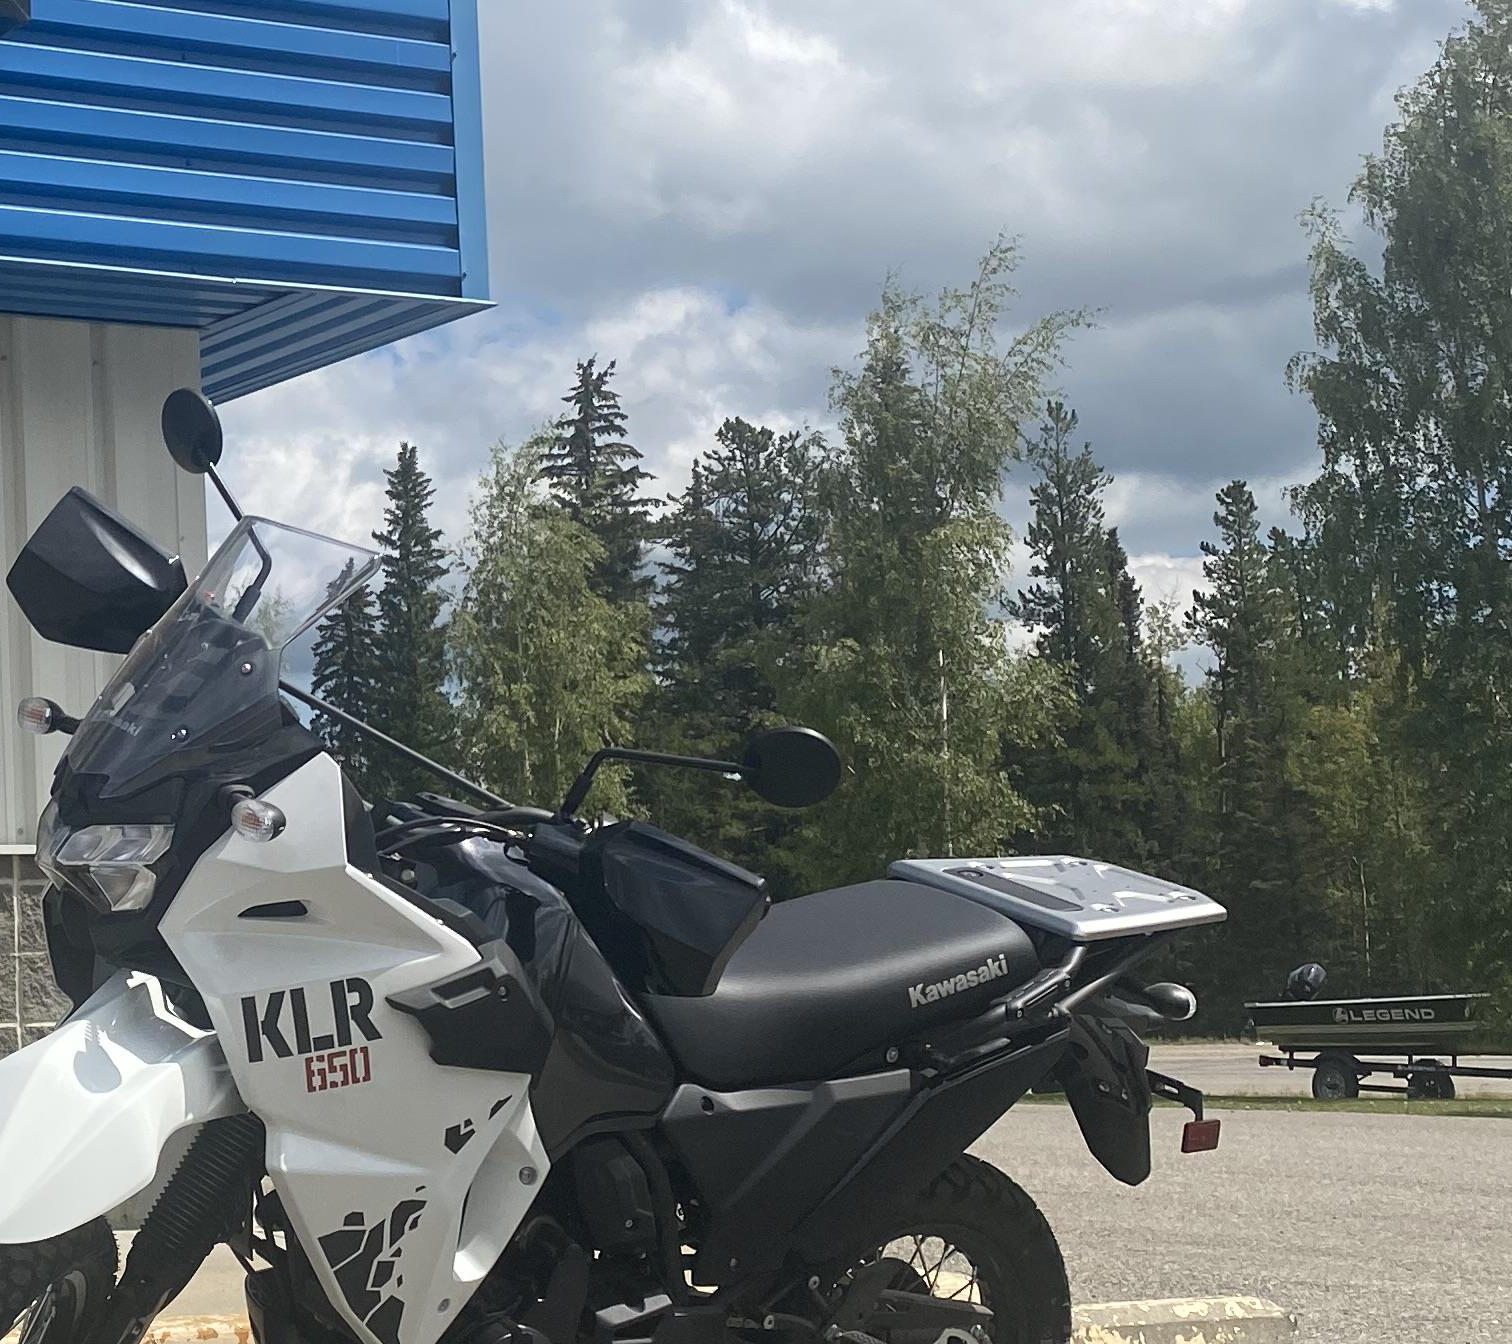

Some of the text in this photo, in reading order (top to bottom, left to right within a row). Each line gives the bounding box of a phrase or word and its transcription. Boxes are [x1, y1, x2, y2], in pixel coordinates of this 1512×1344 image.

[908, 953, 1009, 1008] Kawasaki
[240, 977, 383, 1064] KLR
[1349, 1008, 1435, 1021] LEGEND
[304, 1046, 371, 1093] 650
